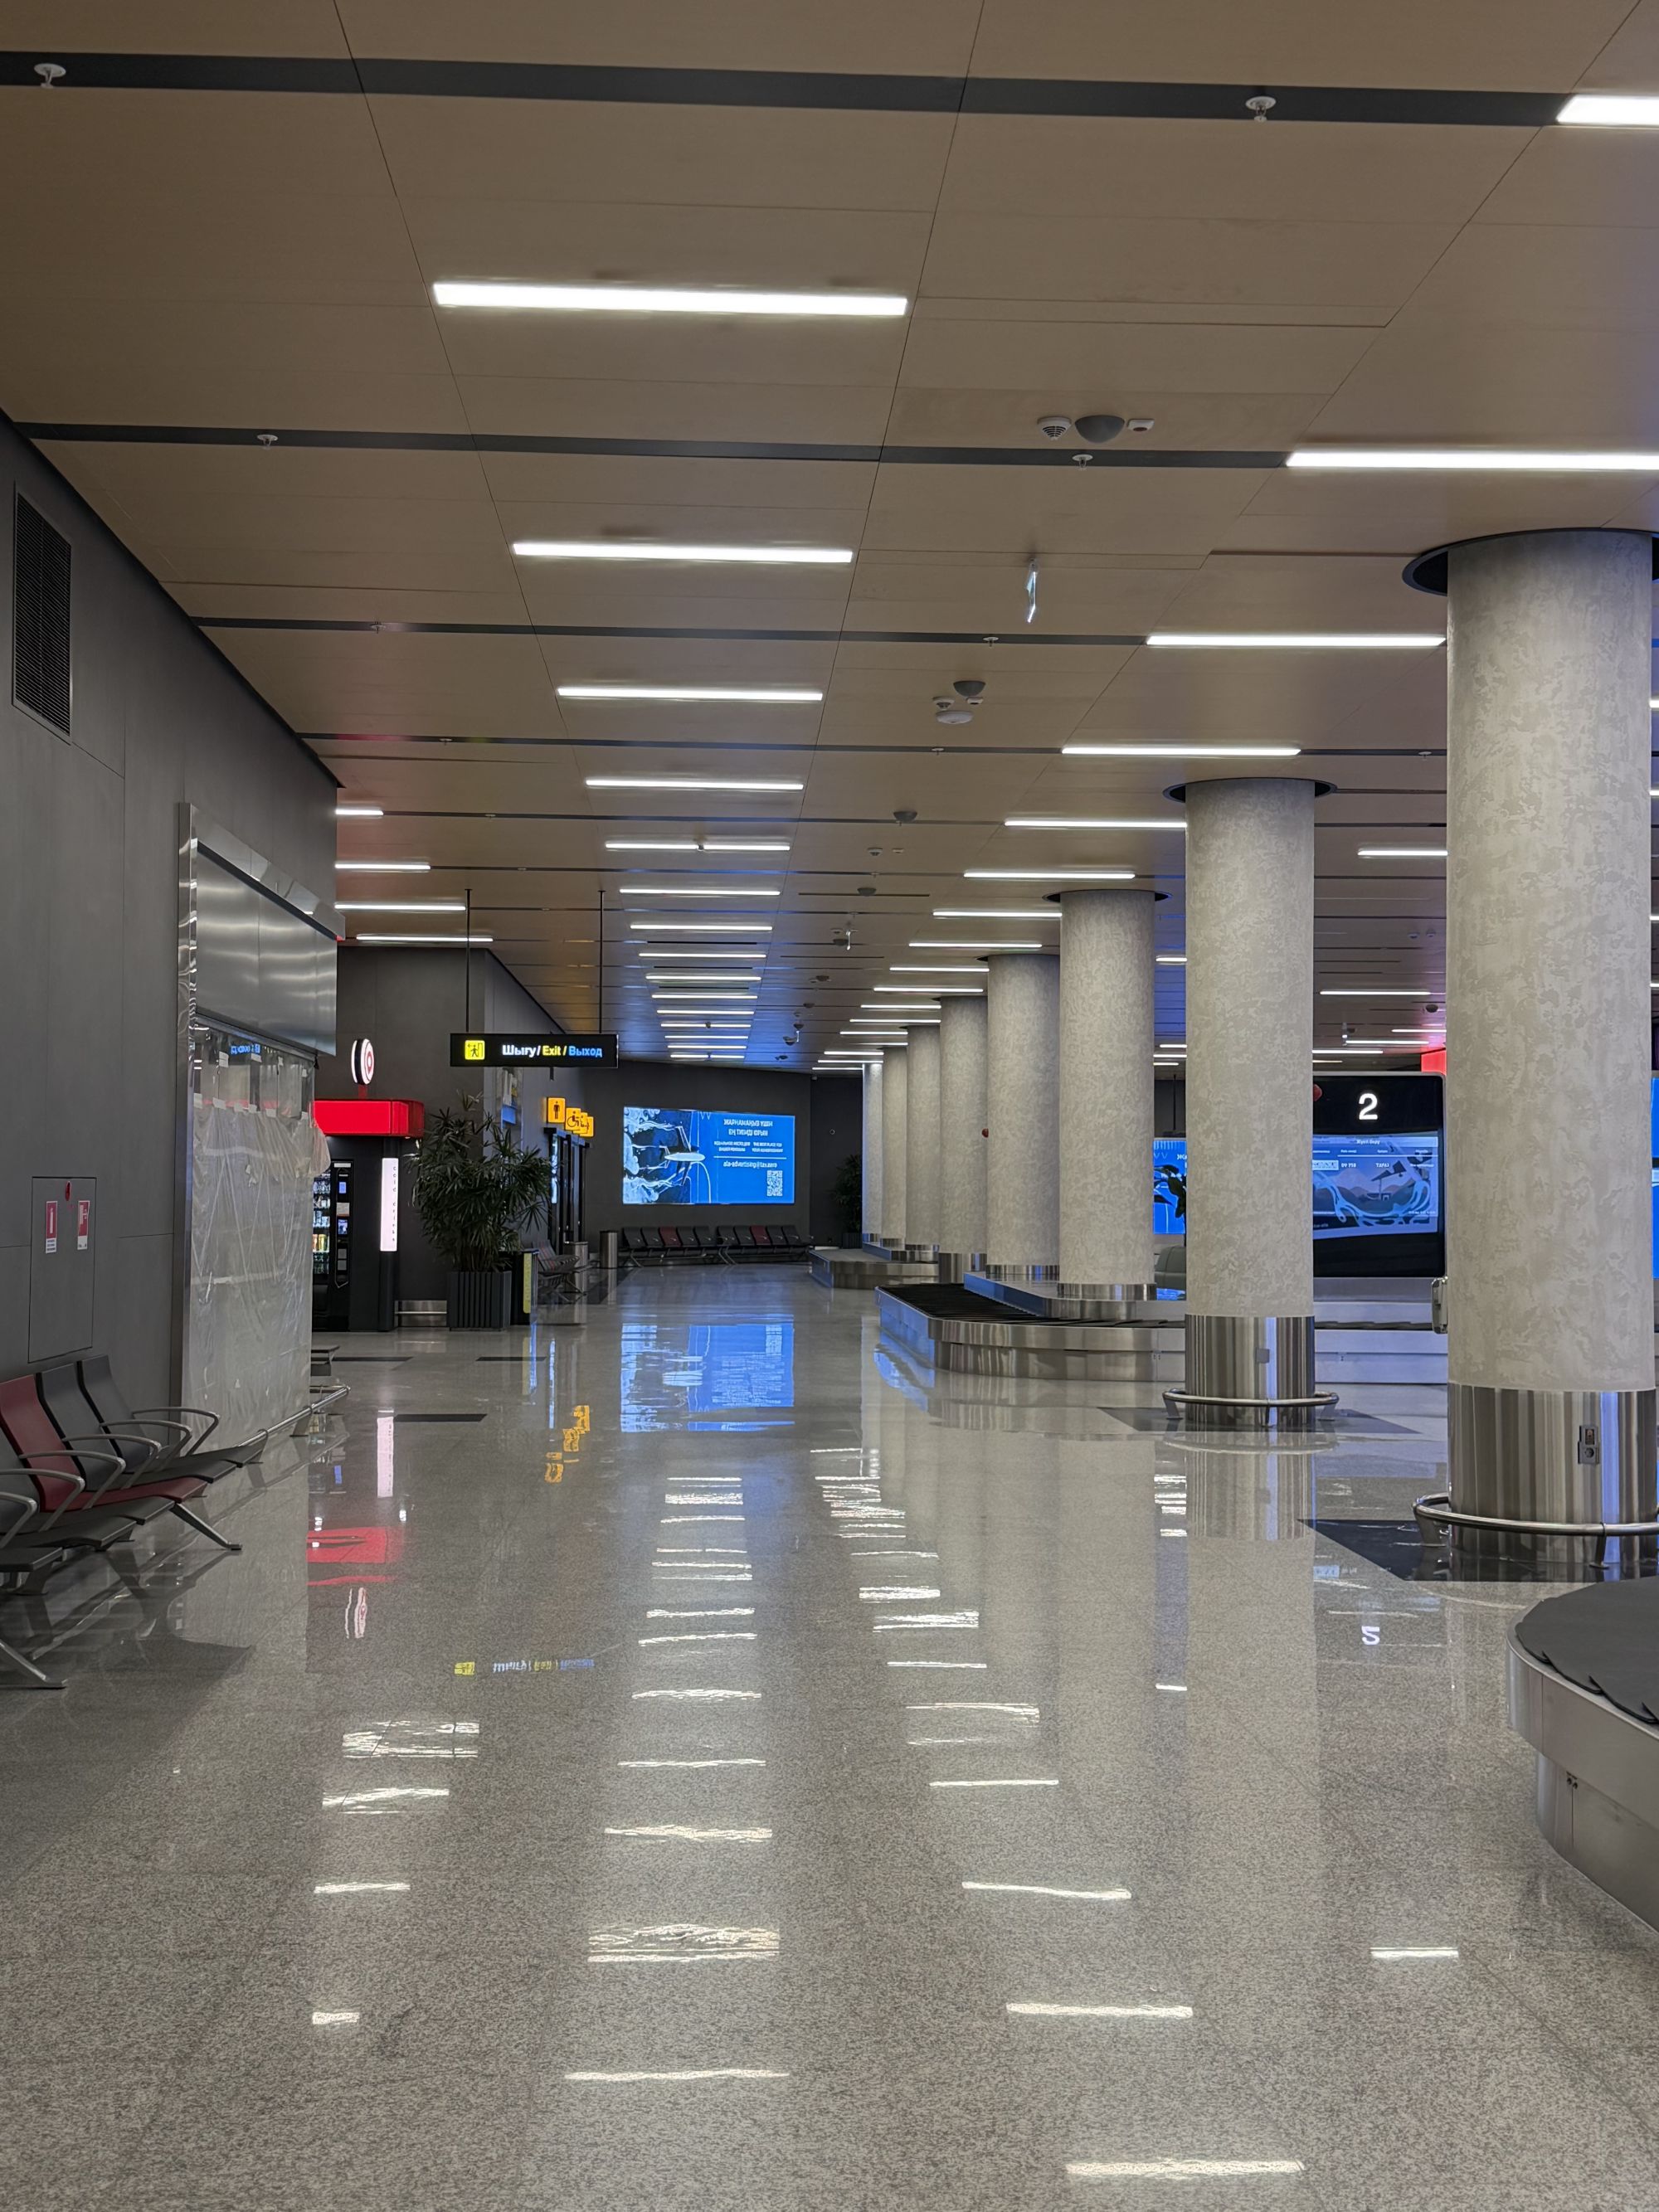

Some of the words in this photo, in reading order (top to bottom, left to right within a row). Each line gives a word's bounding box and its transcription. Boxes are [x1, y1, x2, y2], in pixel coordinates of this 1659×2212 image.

[542, 1046, 561, 1056] Exit
[568, 1046, 602, 1057] Выход
[1359, 1093, 1378, 1120] 2
